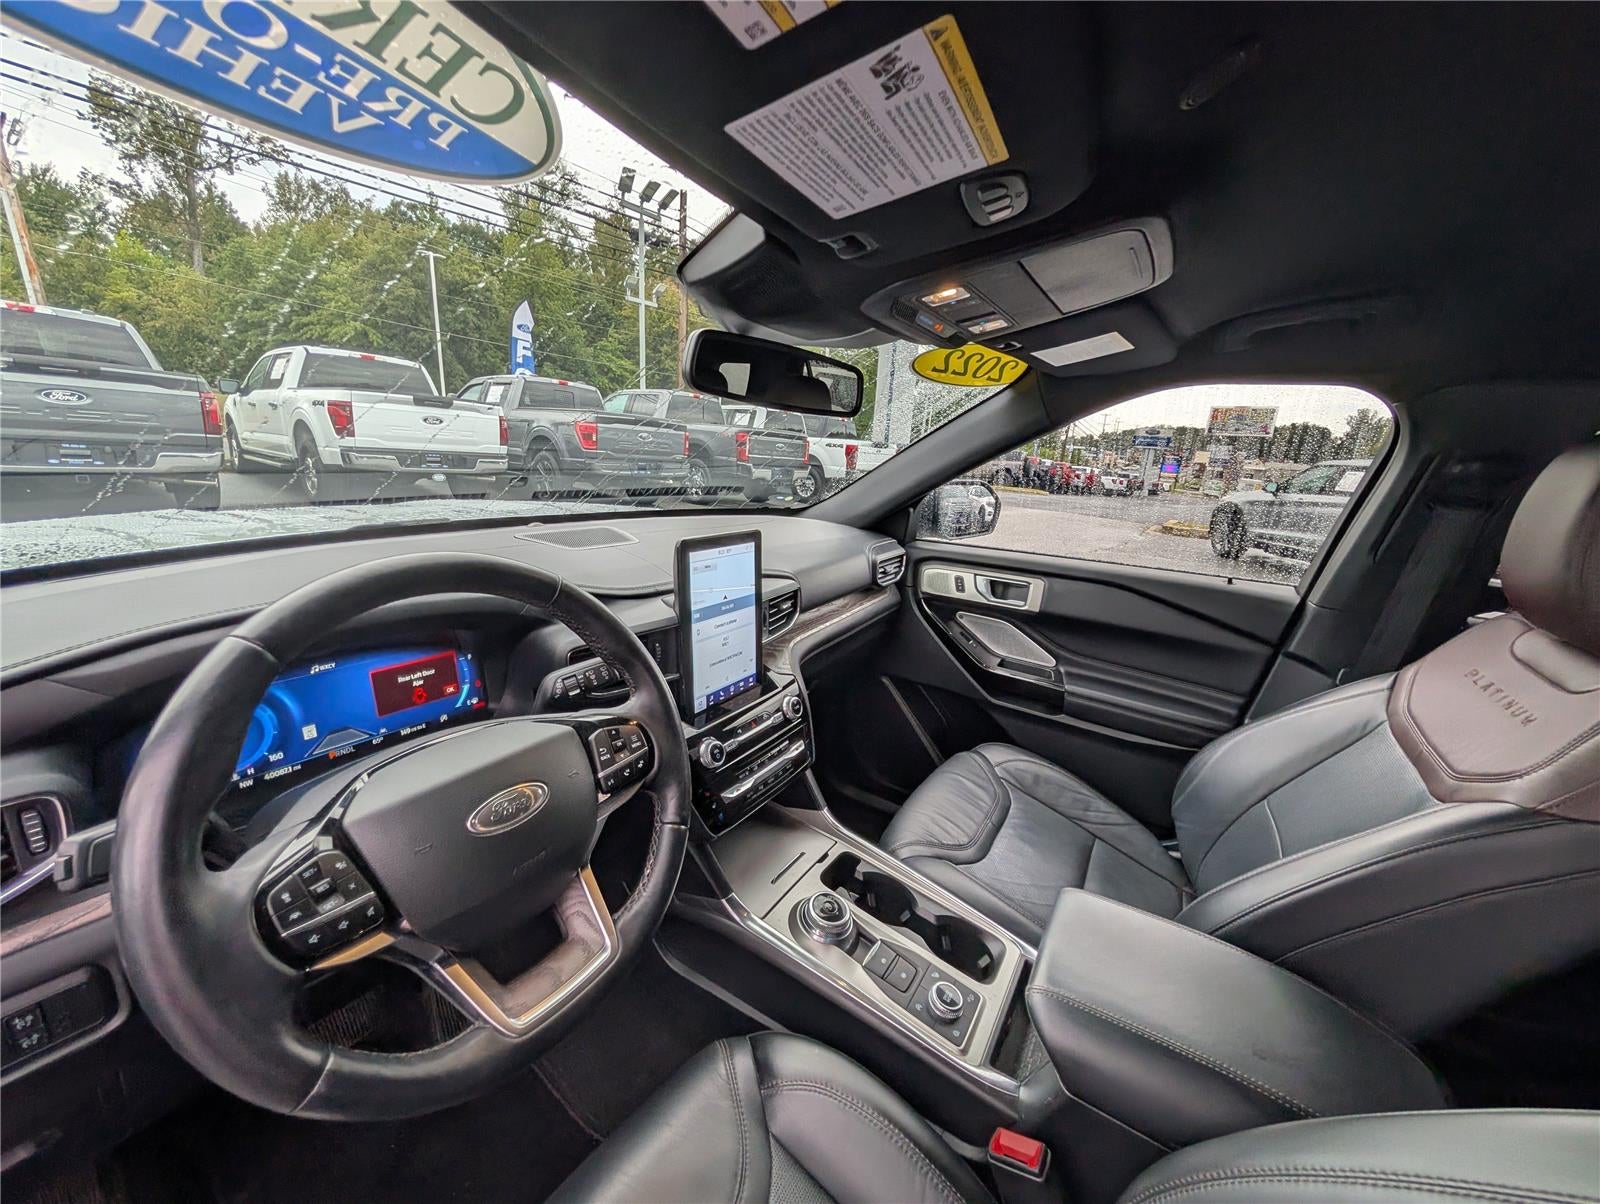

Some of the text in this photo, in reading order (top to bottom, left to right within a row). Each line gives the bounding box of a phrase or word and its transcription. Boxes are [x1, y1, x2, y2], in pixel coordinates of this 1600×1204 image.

[1464, 668, 1538, 728] PLATINUM
[268, 752, 284, 762] 160
[490, 792, 528, 822] Ford
